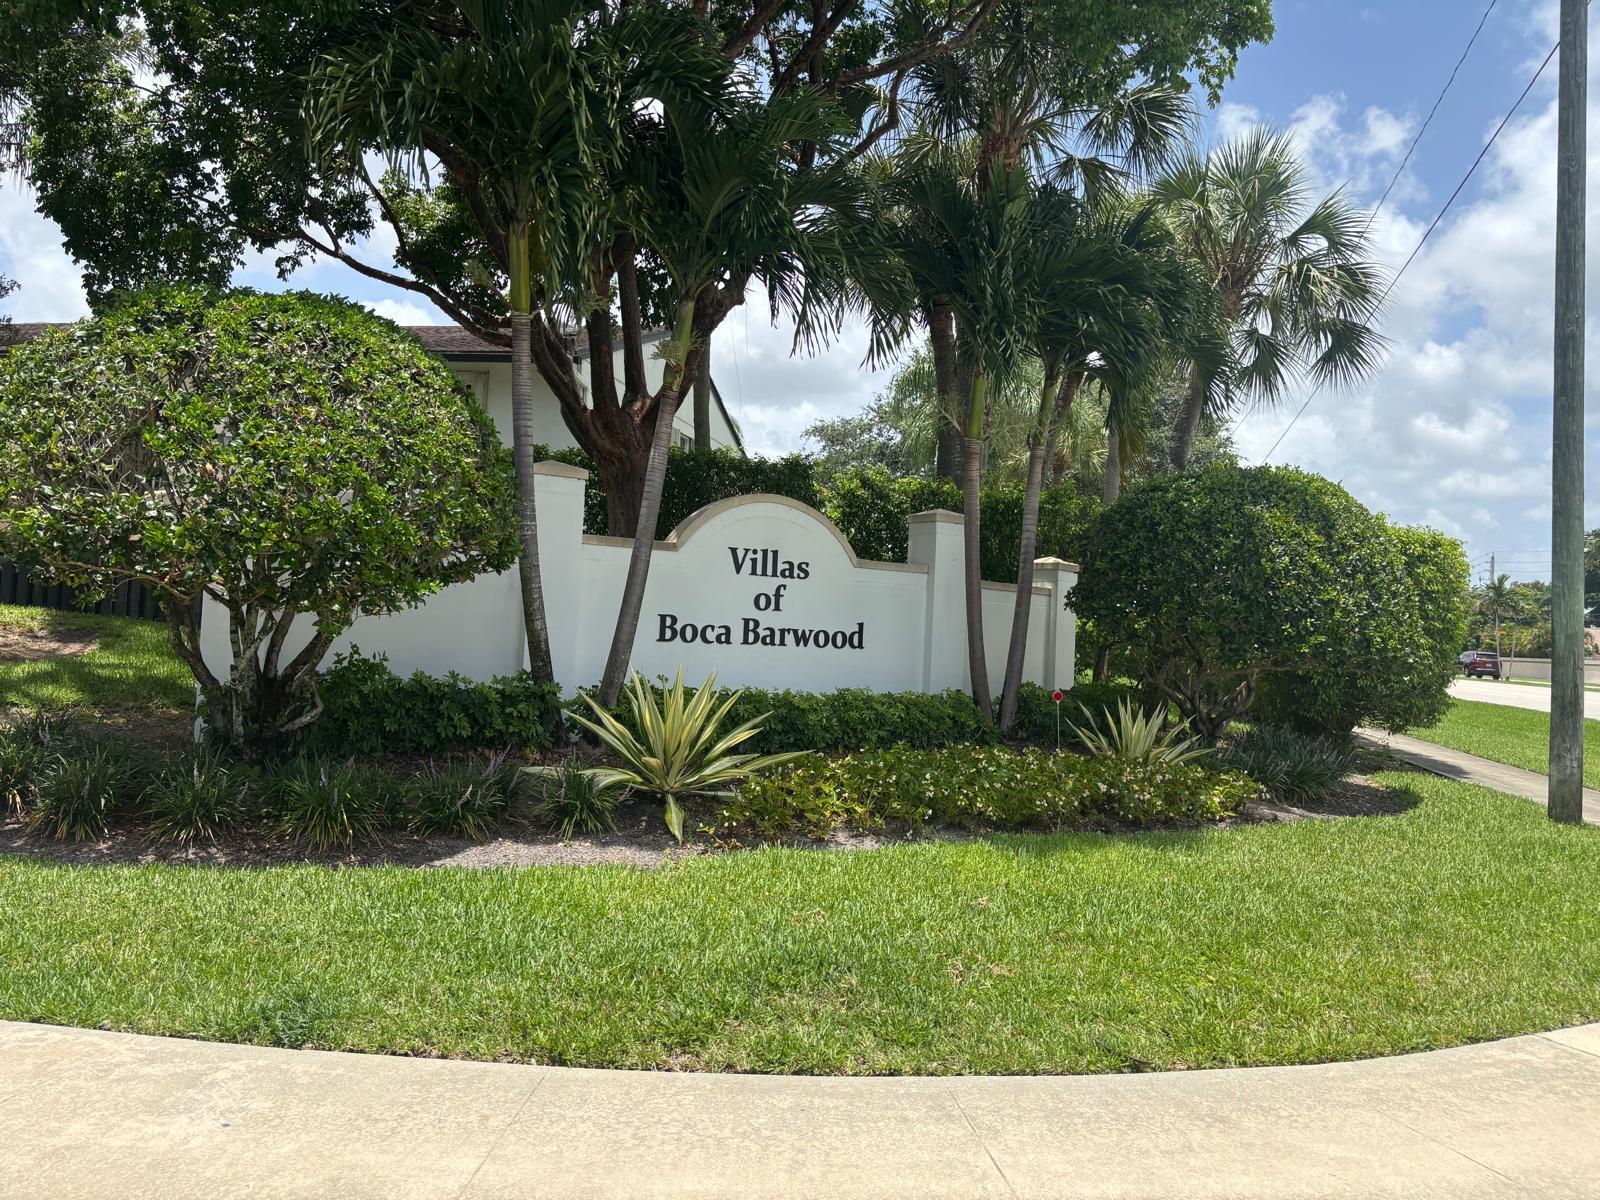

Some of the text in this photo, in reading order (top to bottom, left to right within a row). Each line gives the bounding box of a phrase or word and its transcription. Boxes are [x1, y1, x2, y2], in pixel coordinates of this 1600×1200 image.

[728, 547, 810, 580] Villas
[753, 584, 787, 612] of
[656, 614, 865, 650] Boca Barwood
